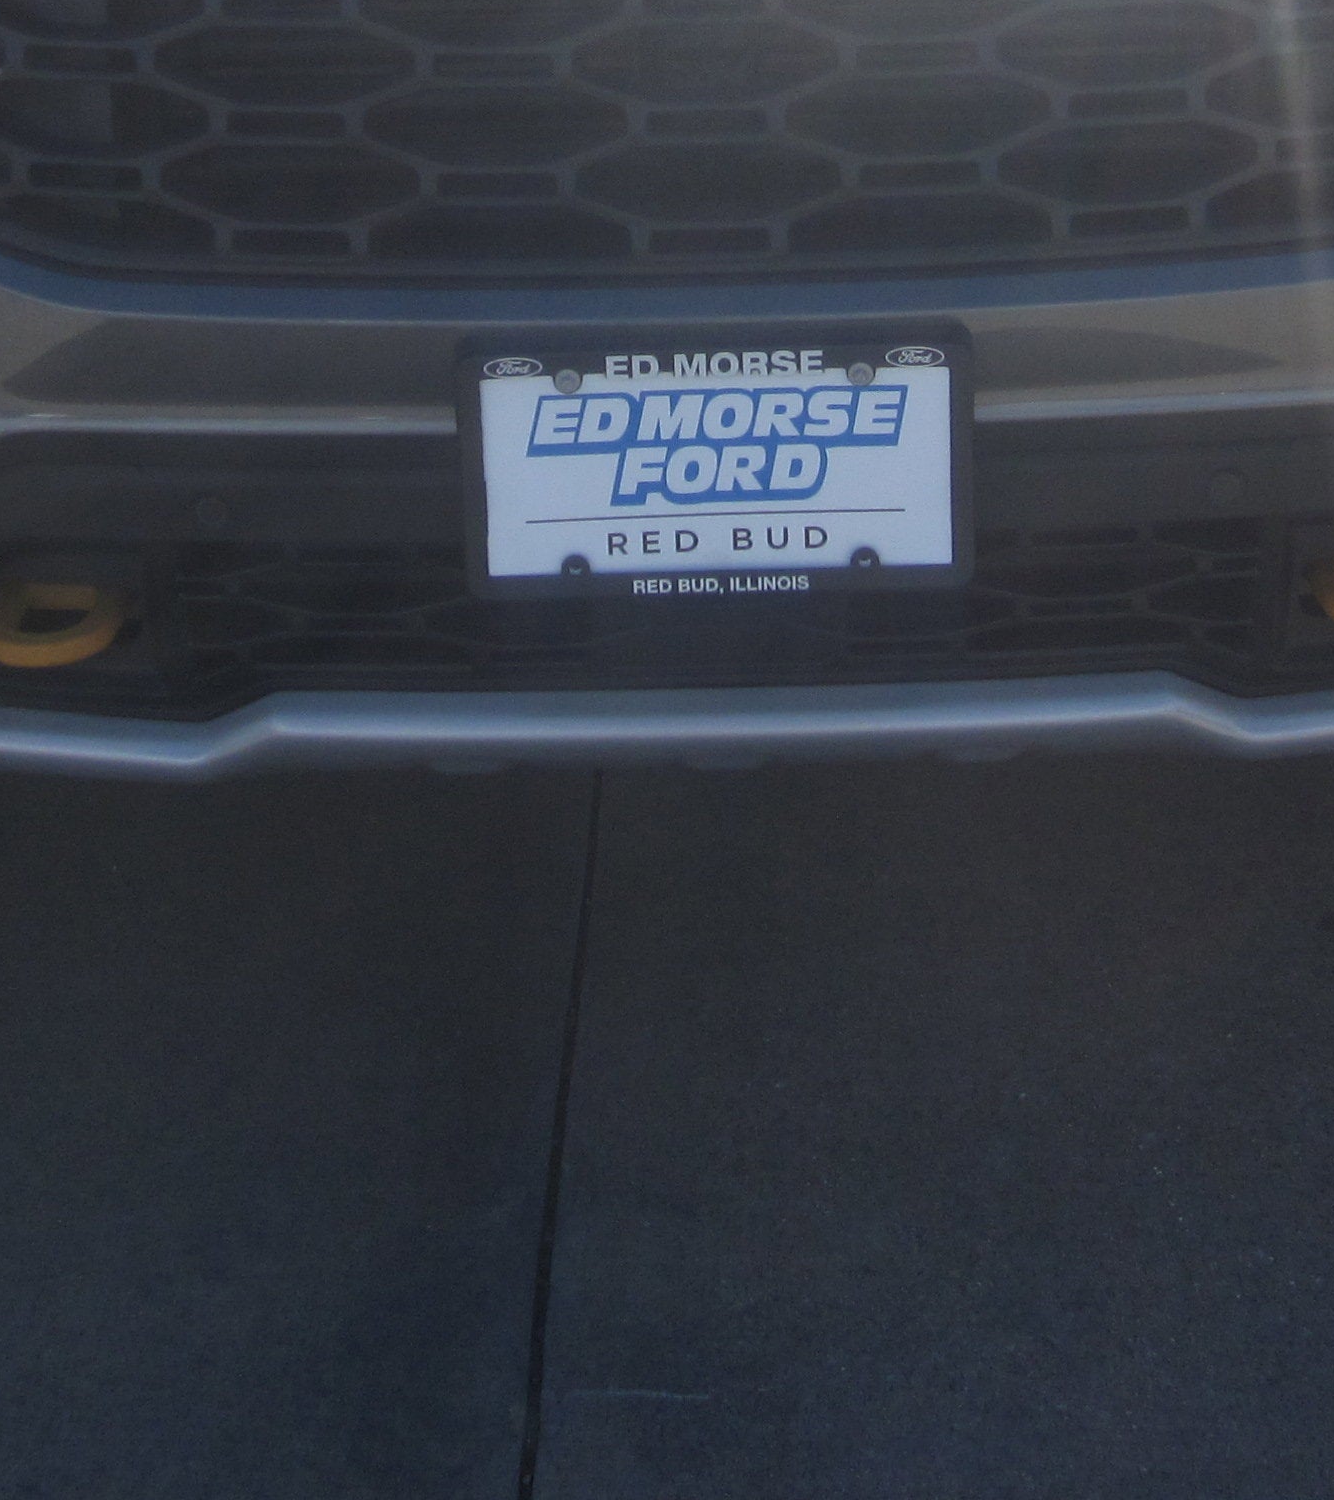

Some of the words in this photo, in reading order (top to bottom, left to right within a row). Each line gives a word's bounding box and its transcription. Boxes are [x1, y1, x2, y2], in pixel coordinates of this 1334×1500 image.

[604, 354, 660, 379] ED
[673, 350, 824, 378] MORSE
[618, 443, 821, 496] FORD
[607, 530, 699, 555] RED
[731, 526, 828, 551] BUD
[632, 578, 671, 595] RED
[678, 577, 724, 595] BUD,
[729, 575, 809, 592] ILLINOIS
